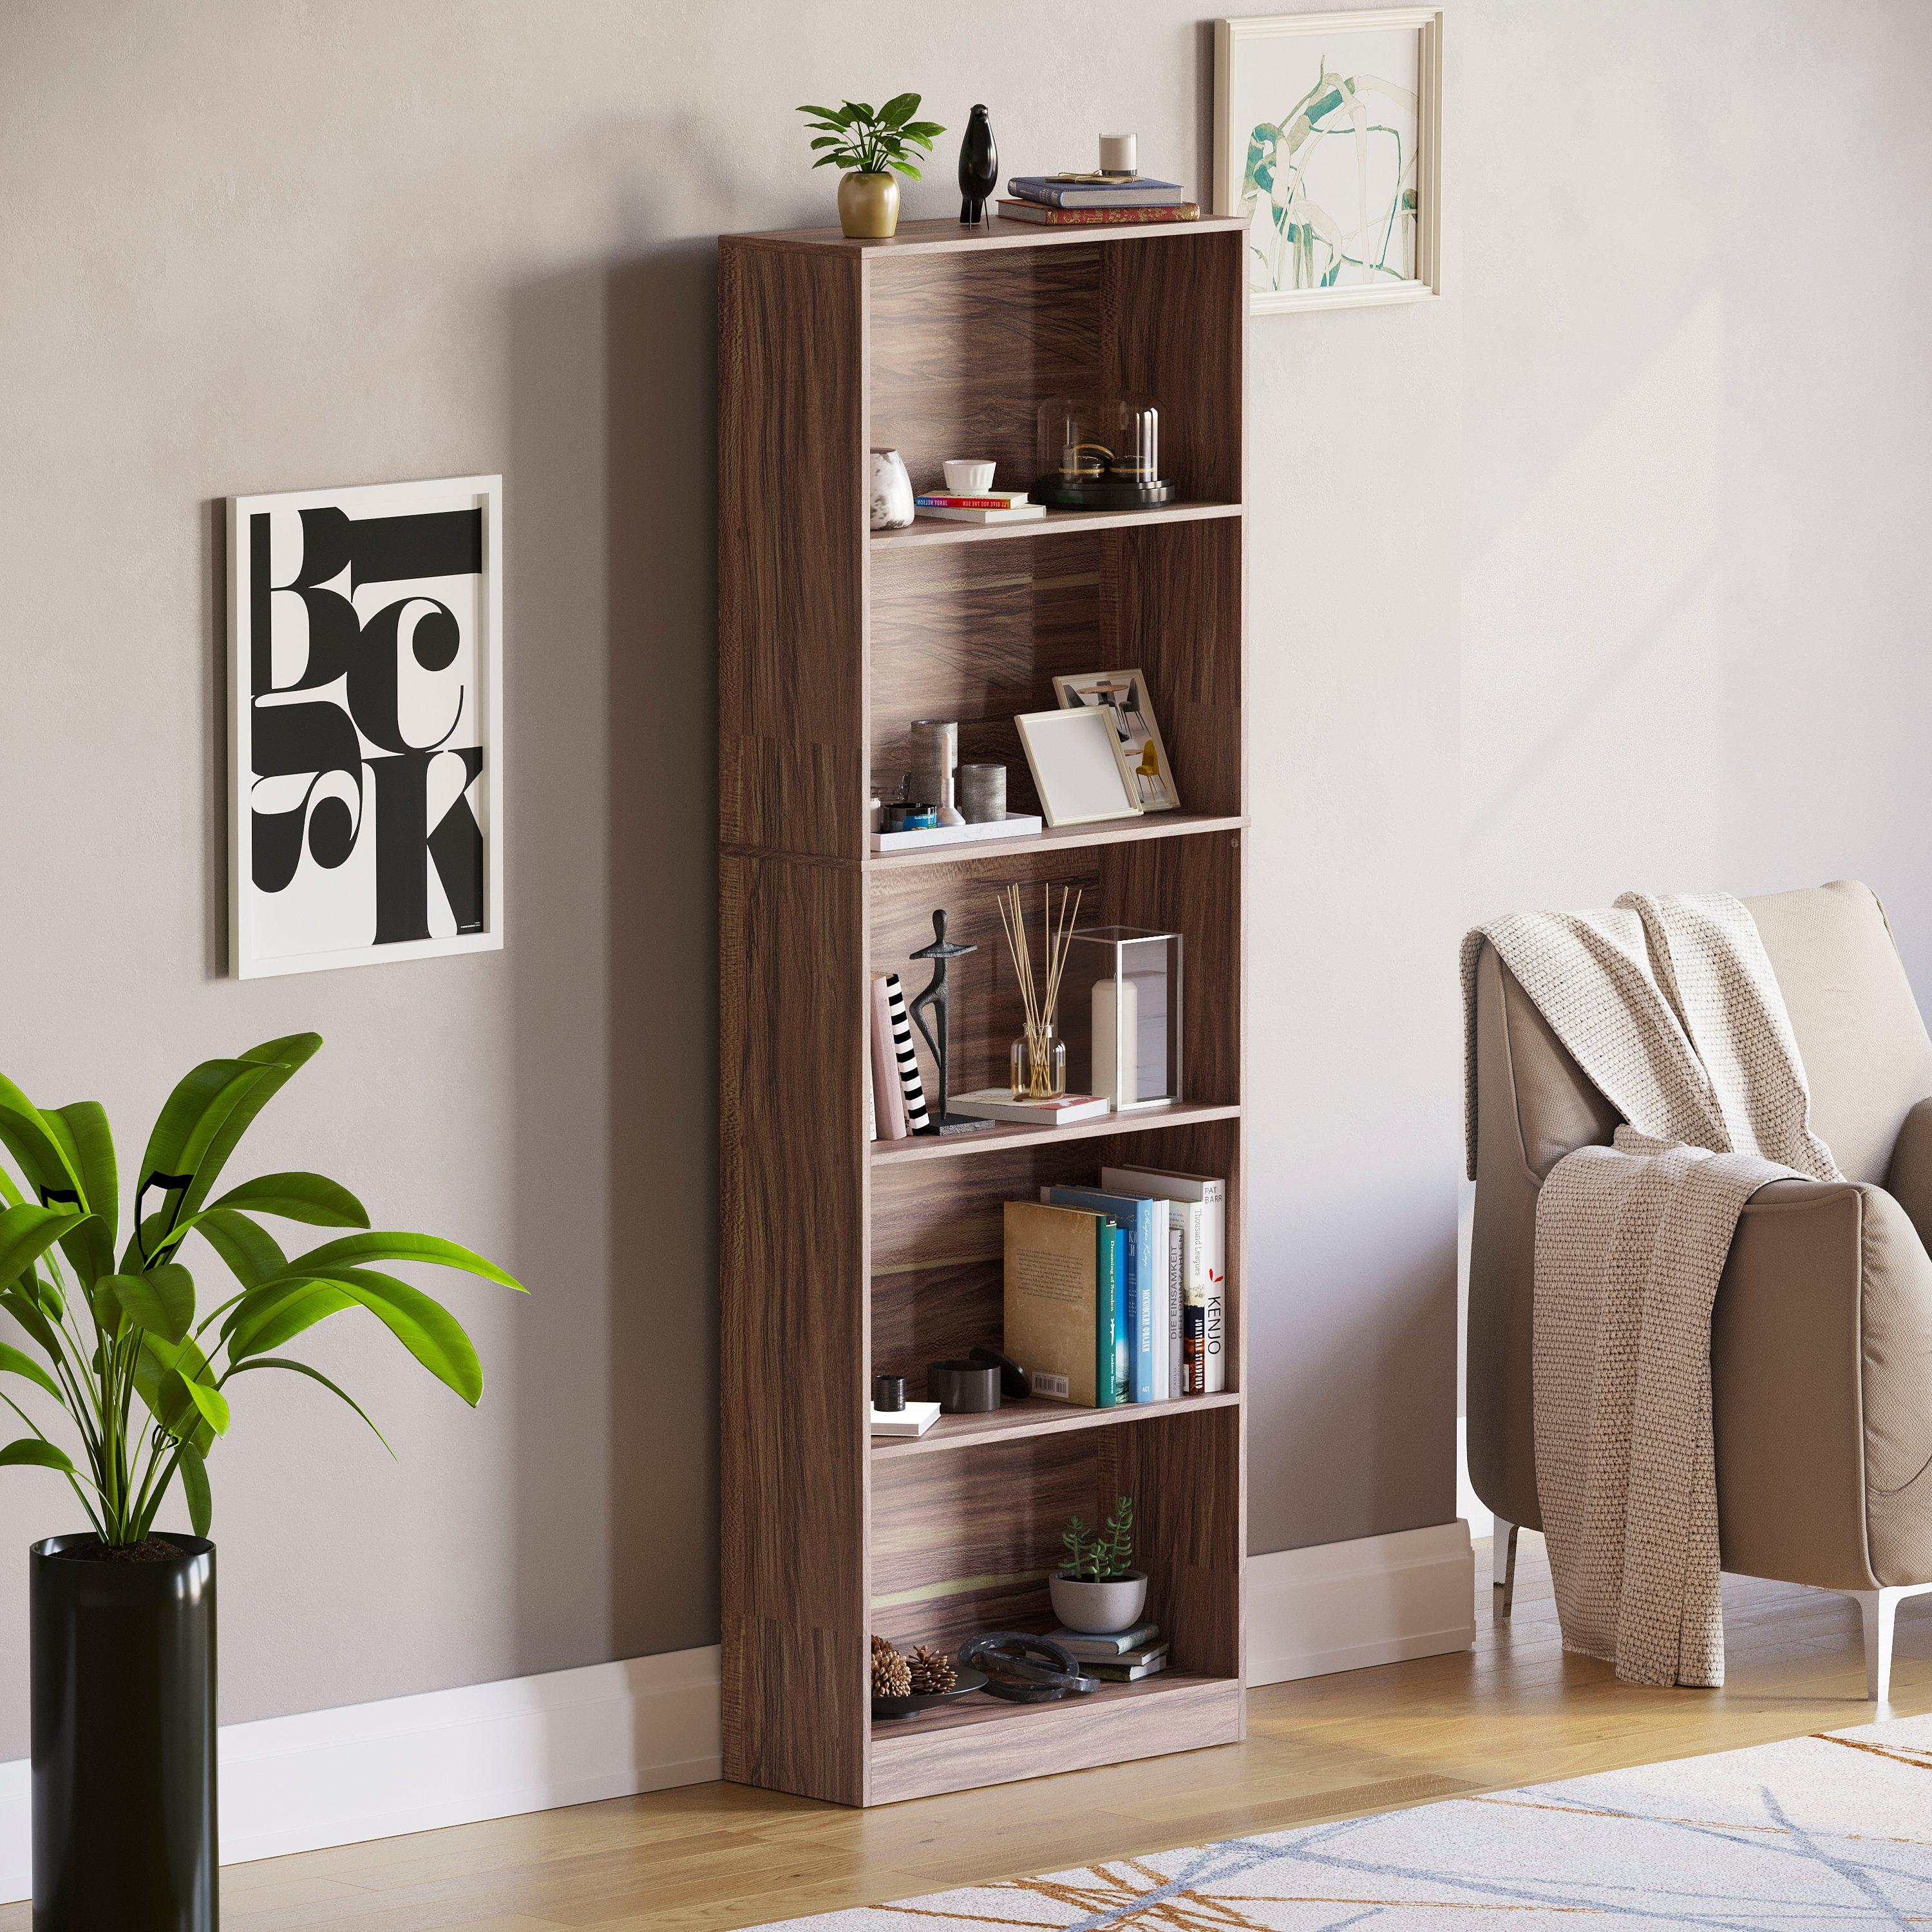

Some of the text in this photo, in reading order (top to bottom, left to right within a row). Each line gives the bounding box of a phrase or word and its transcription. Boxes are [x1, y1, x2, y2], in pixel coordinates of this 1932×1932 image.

[1205, 1195, 1222, 1204] BARR
[1193, 1247, 1202, 1276] Leagues
[1142, 1289, 1150, 1352] МОСКОВСКИЕ ФИАЛКИ
[1208, 1296, 1221, 1355] KENJO
[1195, 1319, 1203, 1389] JONATHAN STANDFORD
